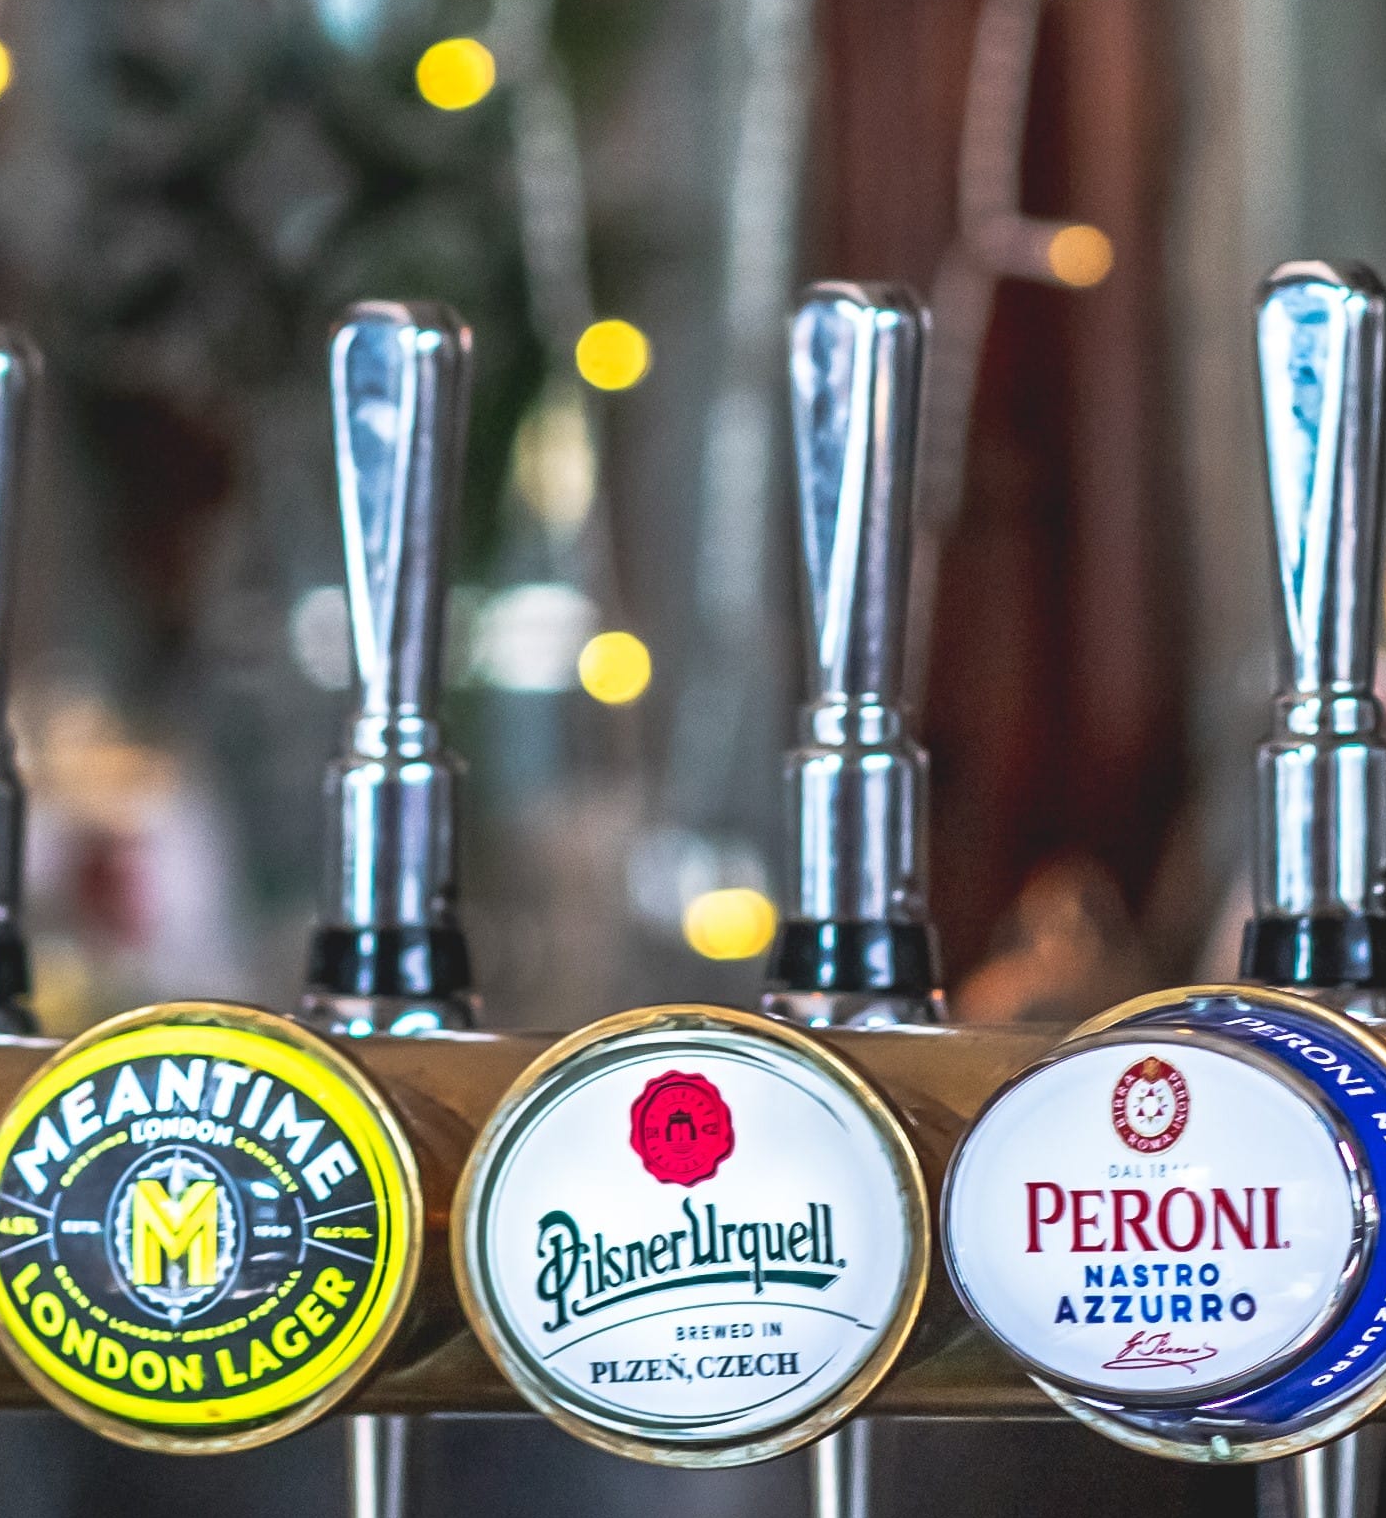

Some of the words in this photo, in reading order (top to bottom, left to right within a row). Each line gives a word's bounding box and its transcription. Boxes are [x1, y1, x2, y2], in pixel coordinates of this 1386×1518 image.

[1221, 1017, 1377, 1096] PERONI
[13, 1059, 359, 1201] MEANTIME
[130, 1116, 235, 1147] LONDON
[1024, 1181, 1282, 1254] PERONI
[1085, 1263, 1220, 1288] NASTRO
[1054, 1292, 1257, 1324] AZZURRO
[12, 1263, 203, 1393] LONDON
[215, 1266, 356, 1389] LAGER
[676, 1323, 754, 1341] BREWED
[762, 1322, 782, 1337] IN
[696, 1352, 801, 1380] CZECH
